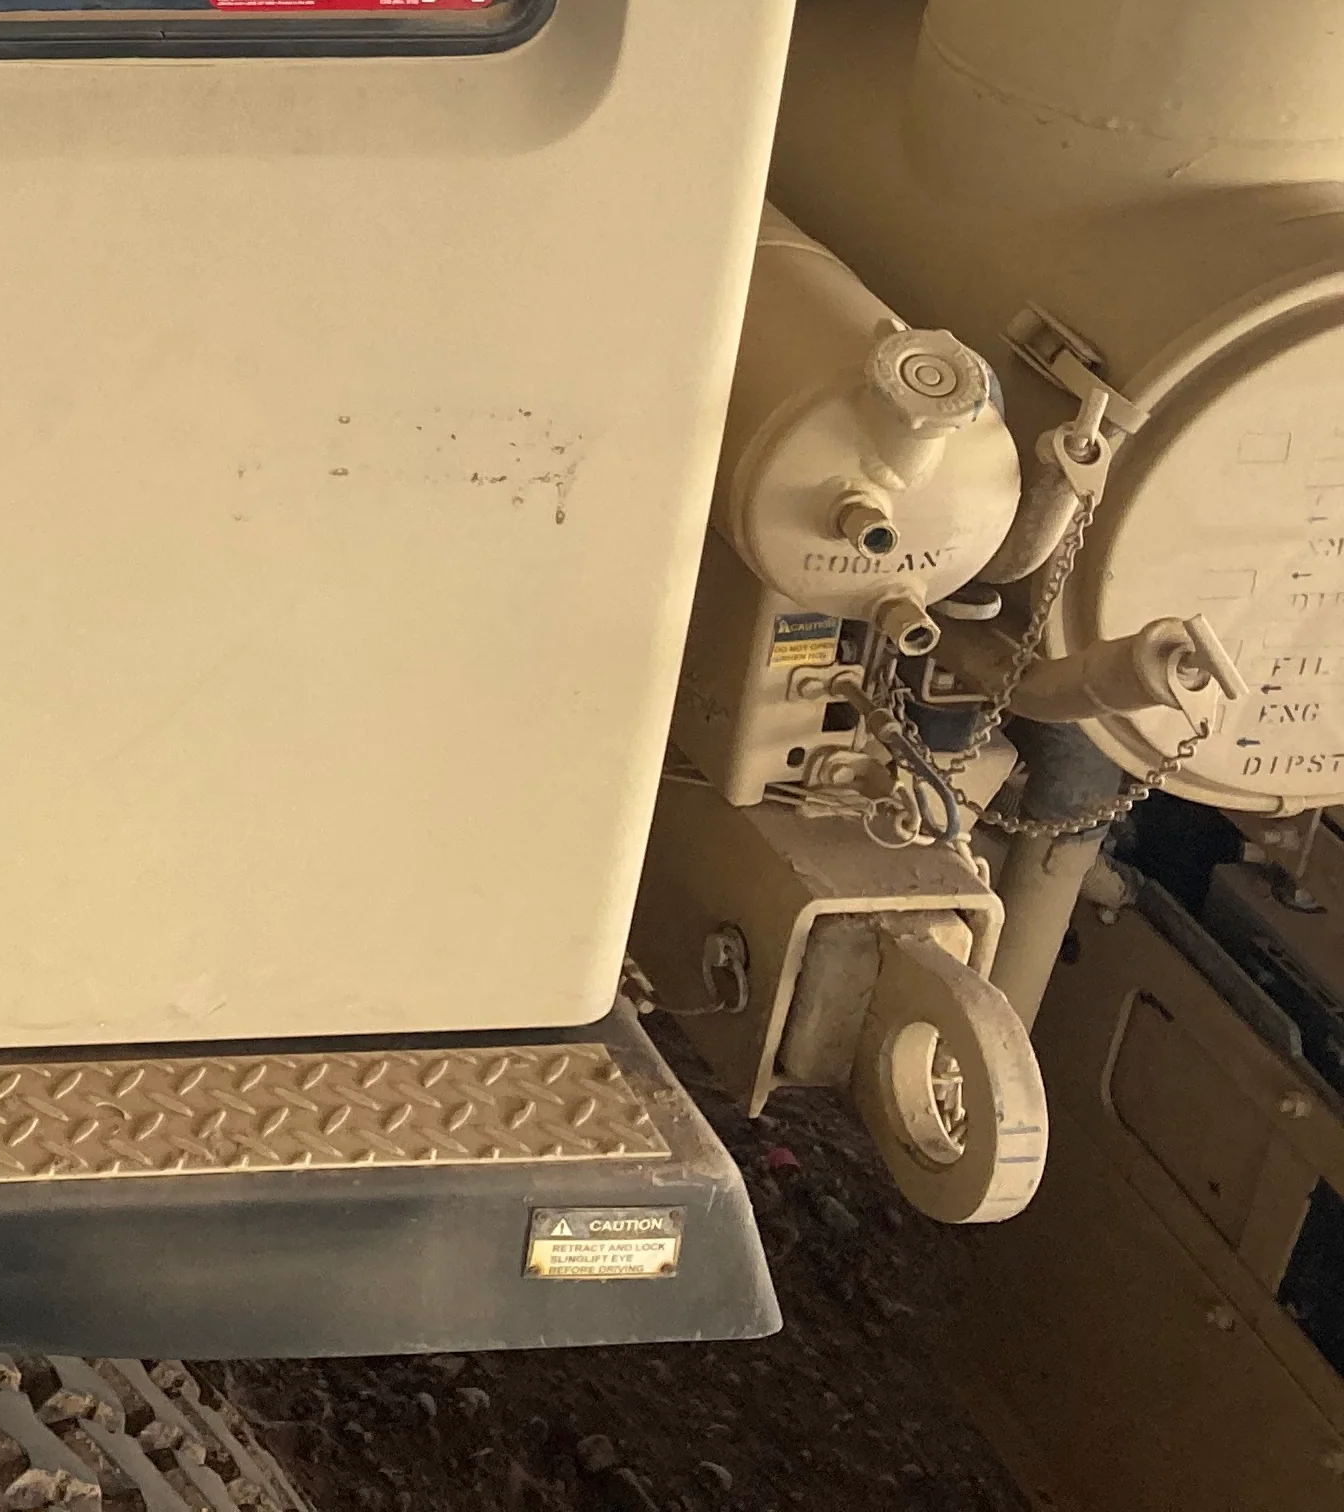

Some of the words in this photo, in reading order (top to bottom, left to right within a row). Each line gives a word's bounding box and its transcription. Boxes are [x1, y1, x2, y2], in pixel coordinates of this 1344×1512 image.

[1259, 703, 1320, 723] ENG
[589, 1218, 664, 1232] CAUTION
[552, 1243, 605, 1253] RETRACT
[608, 1243, 633, 1252] AND
[635, 1242, 665, 1252] LOCK
[612, 1254, 634, 1263] EYE
[548, 1265, 595, 1275] BEFORE
[598, 1264, 645, 1274] DRIVING
